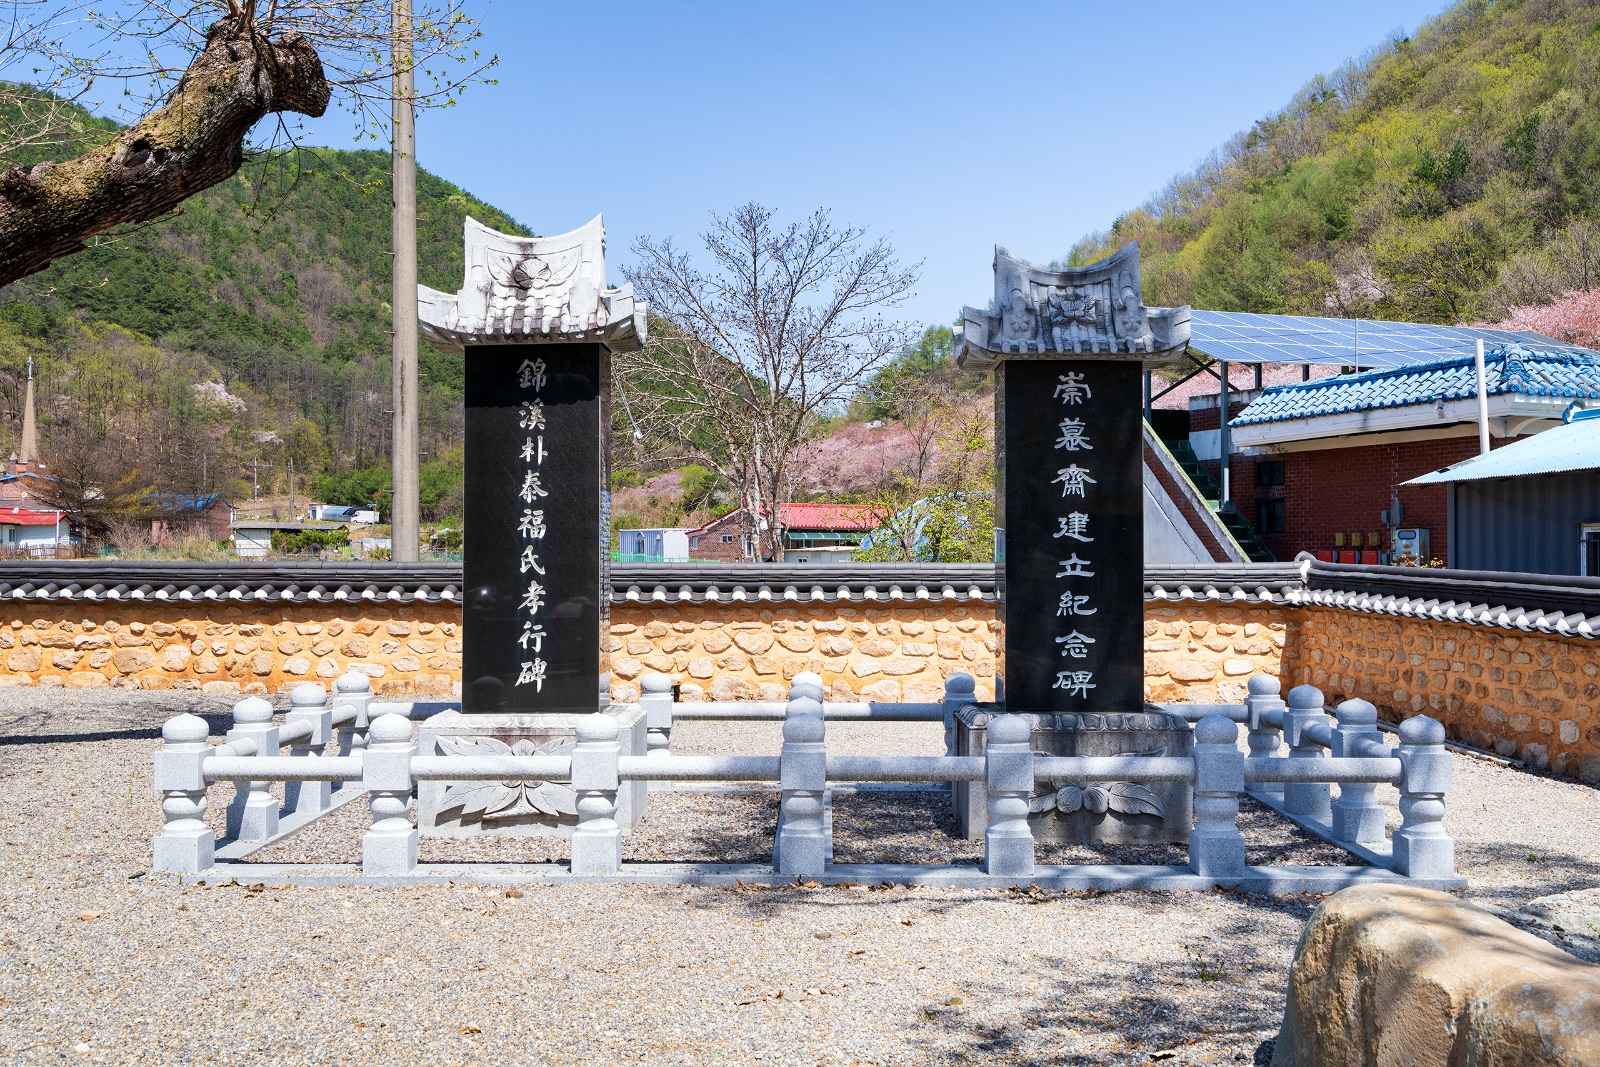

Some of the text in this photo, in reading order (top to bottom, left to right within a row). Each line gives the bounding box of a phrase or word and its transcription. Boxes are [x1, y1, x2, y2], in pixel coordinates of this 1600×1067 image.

[515, 358, 549, 693] 錦溪朴泰福氏孝行碑
